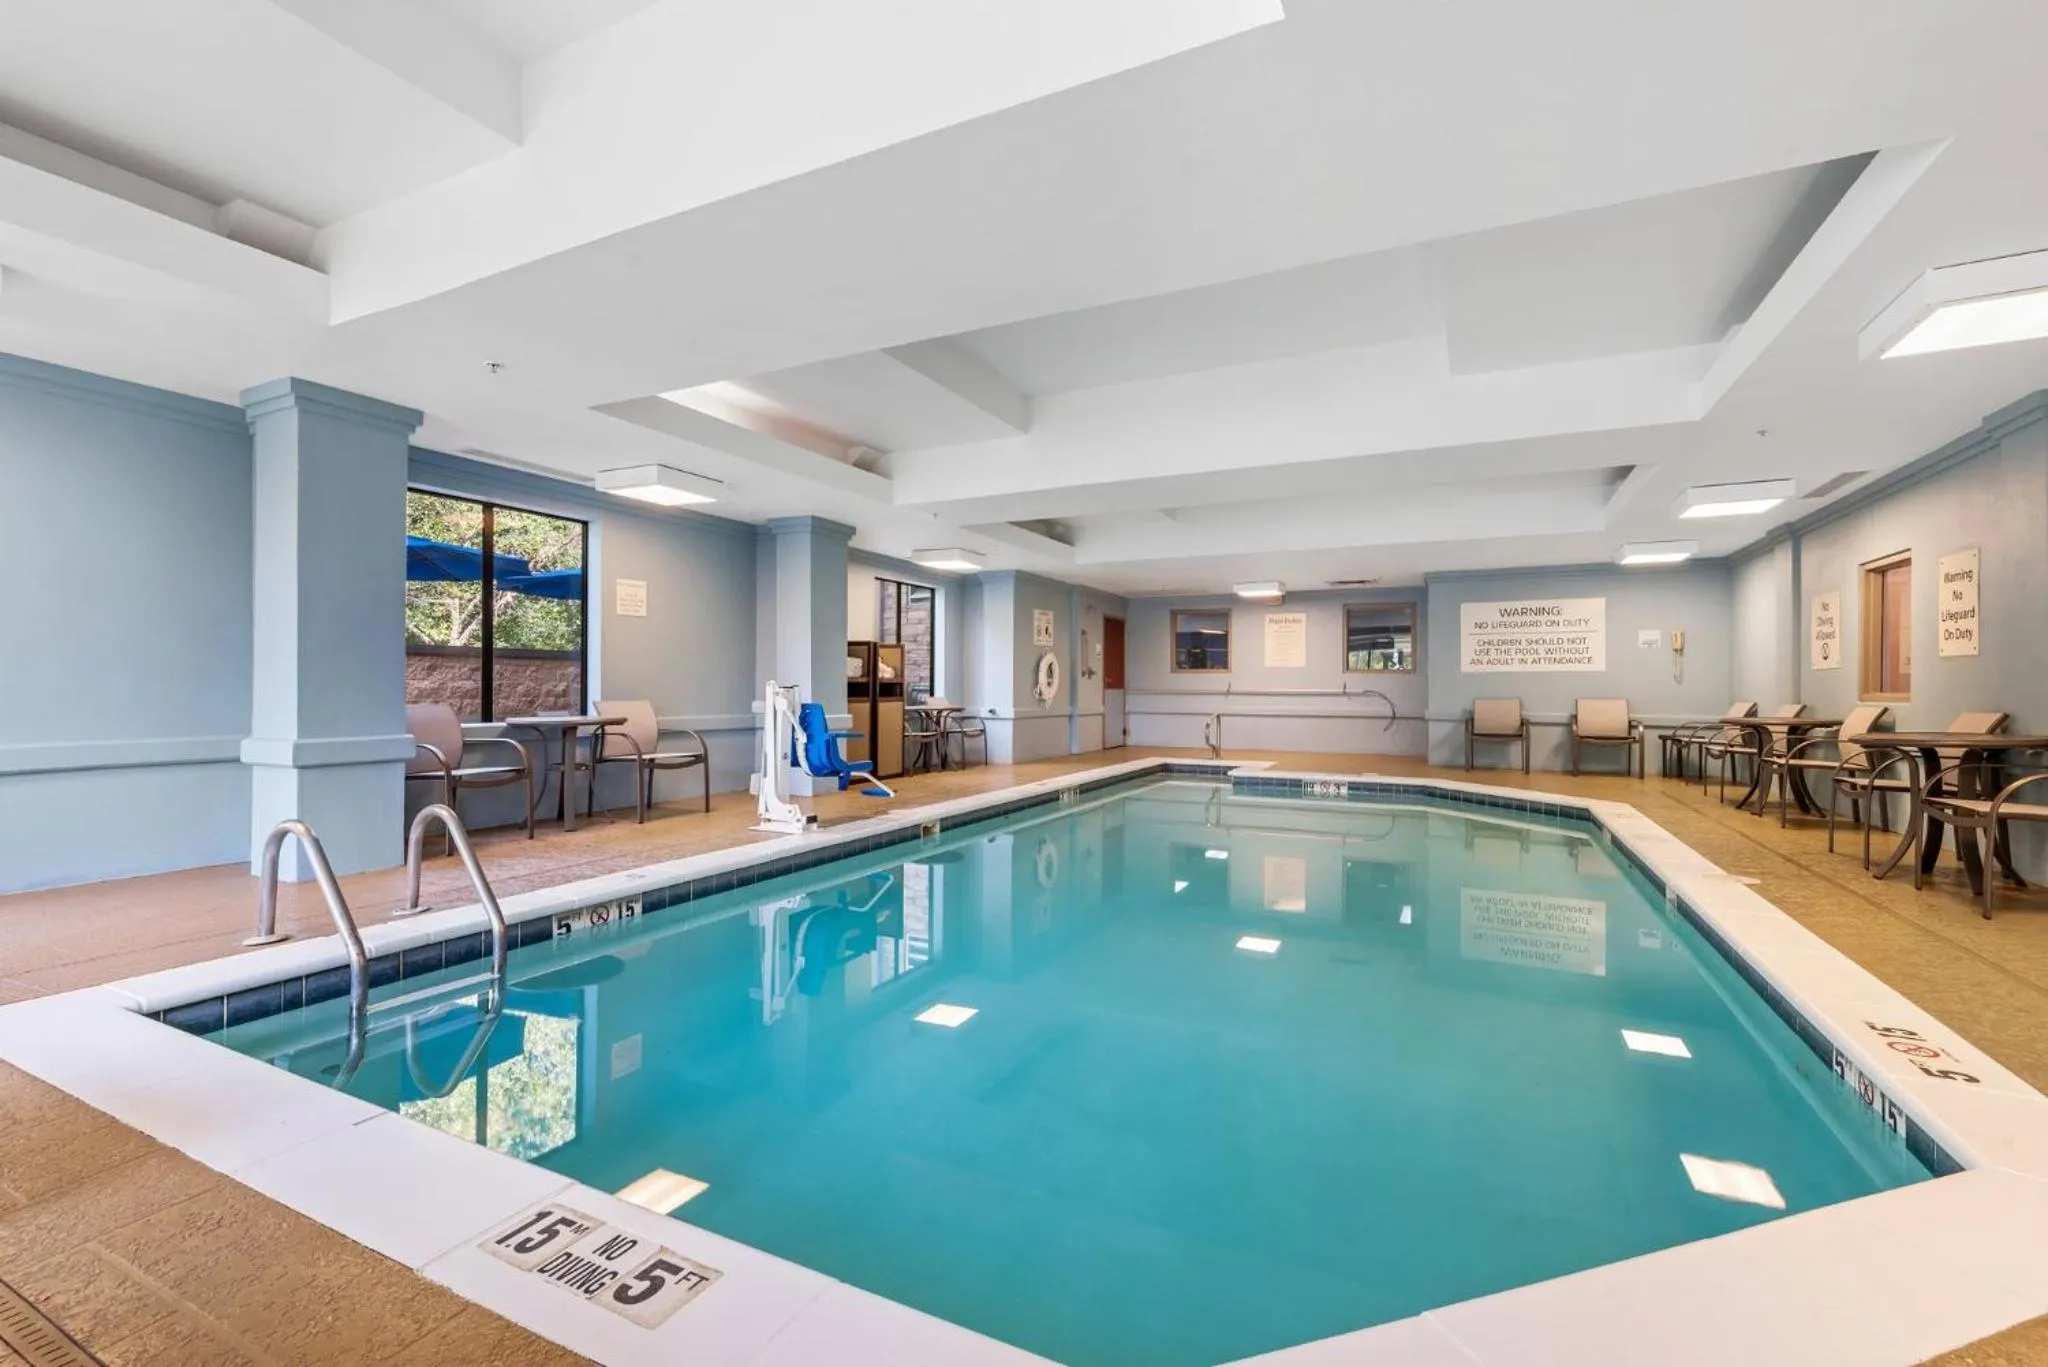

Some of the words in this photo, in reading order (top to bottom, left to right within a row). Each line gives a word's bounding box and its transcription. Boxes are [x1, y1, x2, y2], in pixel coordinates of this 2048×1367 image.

[1944, 569, 1974, 583] Warning
[1952, 589, 1963, 601] No
[1941, 606, 1976, 623] Lifeguard
[1474, 621, 1489, 629] NO
[1491, 619, 1542, 629] LIFEGUARD
[1545, 619, 1560, 627] ON
[1563, 618, 1590, 627] DUTY
[1944, 629, 1954, 641] On
[1955, 627, 1973, 641] Duty
[1476, 638, 1522, 647] CHILDREN
[1526, 637, 1564, 646] SHOULD
[1566, 637, 1587, 645] NOT
[1474, 648, 1491, 656] USE
[1494, 648, 1512, 656] THE
[1515, 647, 1540, 656] POOL
[1544, 646, 1590, 655] WITHOUT
[1470, 657, 1484, 665] AN
[1486, 657, 1514, 665] ADULT
[1519, 657, 1528, 665] IN
[592, 1233, 639, 1262] NO
[536, 1251, 619, 1297] DIVING
